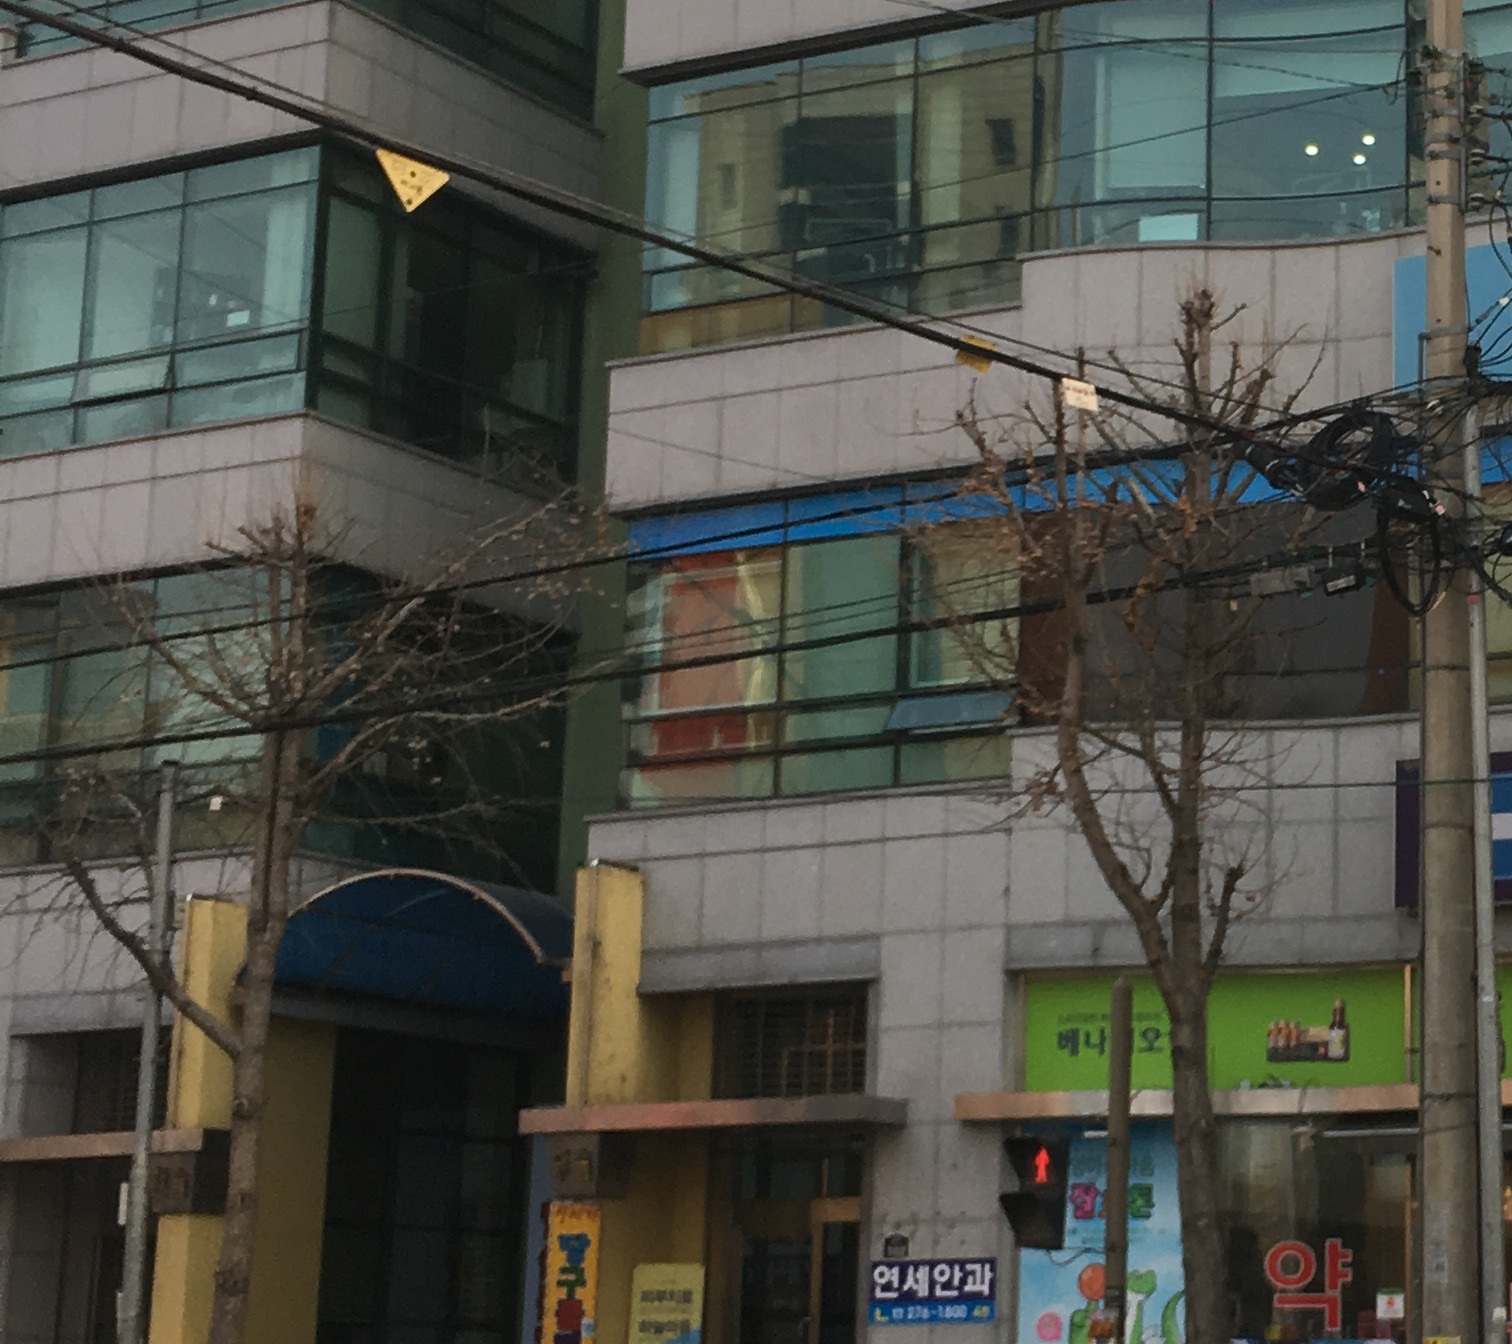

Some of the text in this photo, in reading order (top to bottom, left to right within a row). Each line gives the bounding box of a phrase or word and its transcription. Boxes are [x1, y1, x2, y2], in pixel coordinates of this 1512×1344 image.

[1057, 1026, 1165, 1057] 베나오
[873, 1263, 993, 1298] 연세안과
[1264, 1238, 1353, 1332] 약
